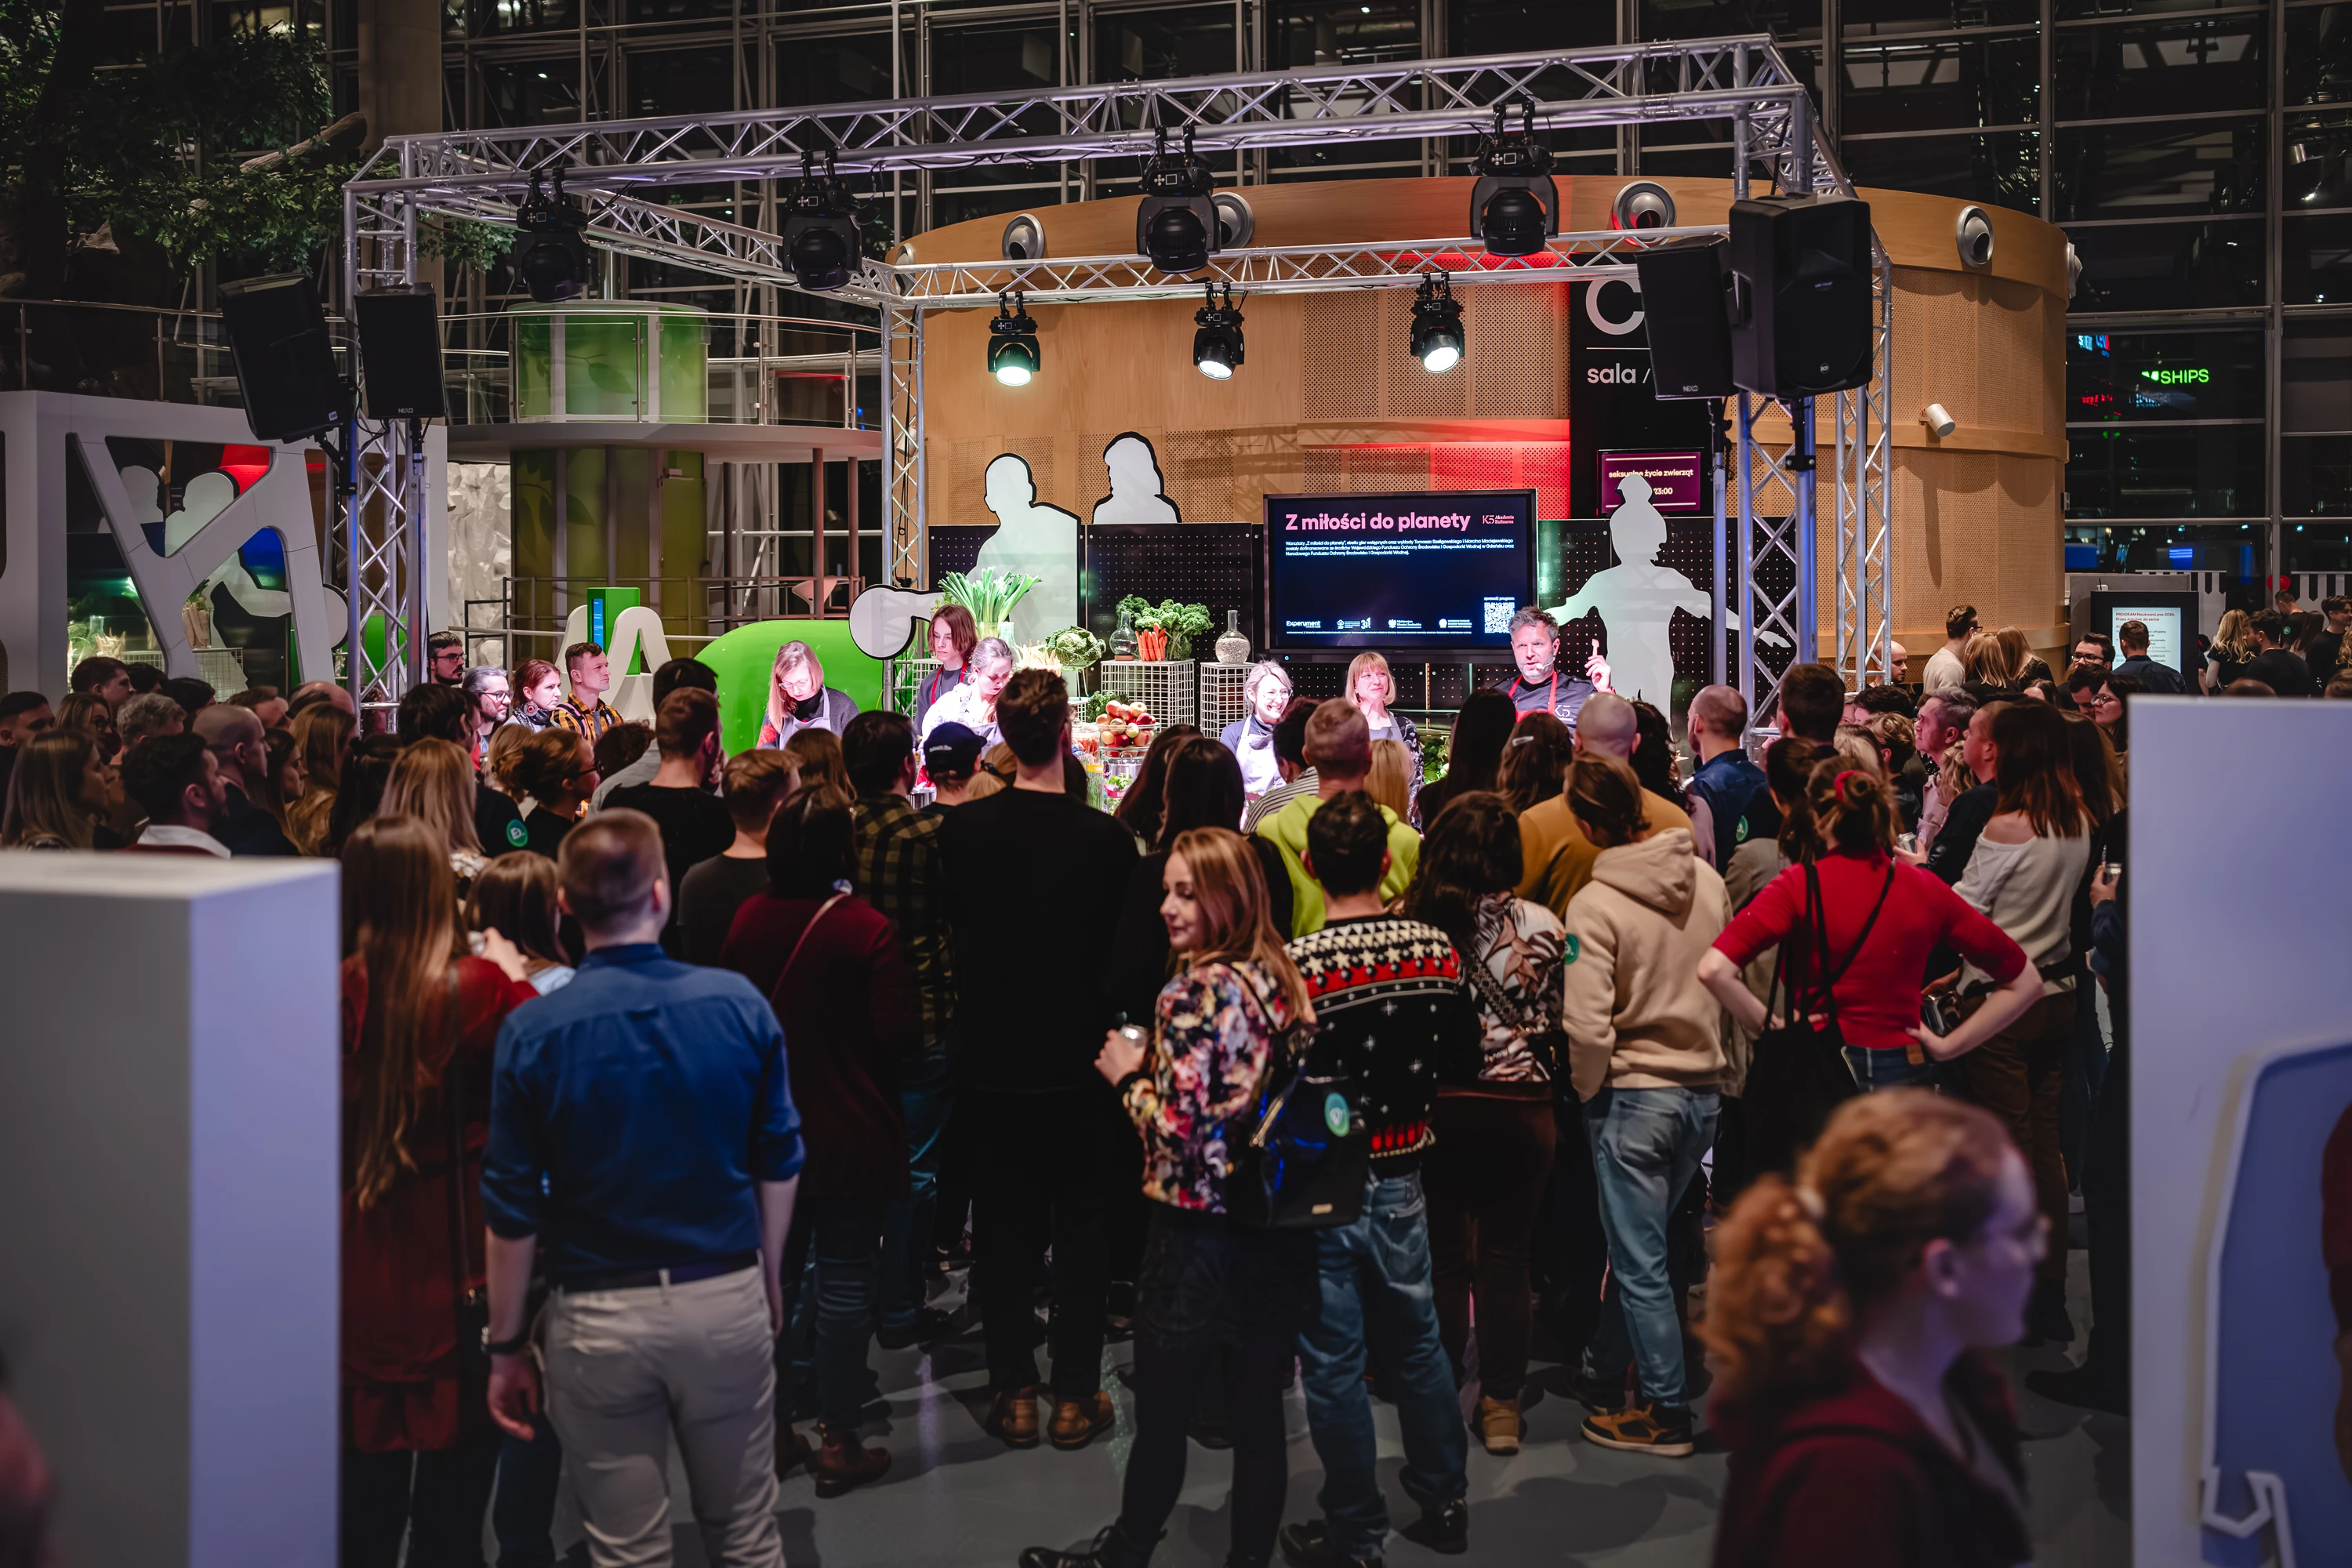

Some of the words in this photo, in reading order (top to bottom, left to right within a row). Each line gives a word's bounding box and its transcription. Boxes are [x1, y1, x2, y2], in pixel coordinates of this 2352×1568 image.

[1587, 363, 1636, 384] sala
[2160, 368, 2209, 384] SHIPS
[1644, 469, 1663, 478] życie
[1285, 514, 1298, 530] Z
[1301, 513, 1366, 530] miłości
[1370, 512, 1394, 529] do
[1398, 512, 1471, 532] planety
[1482, 514, 1495, 524] K5
